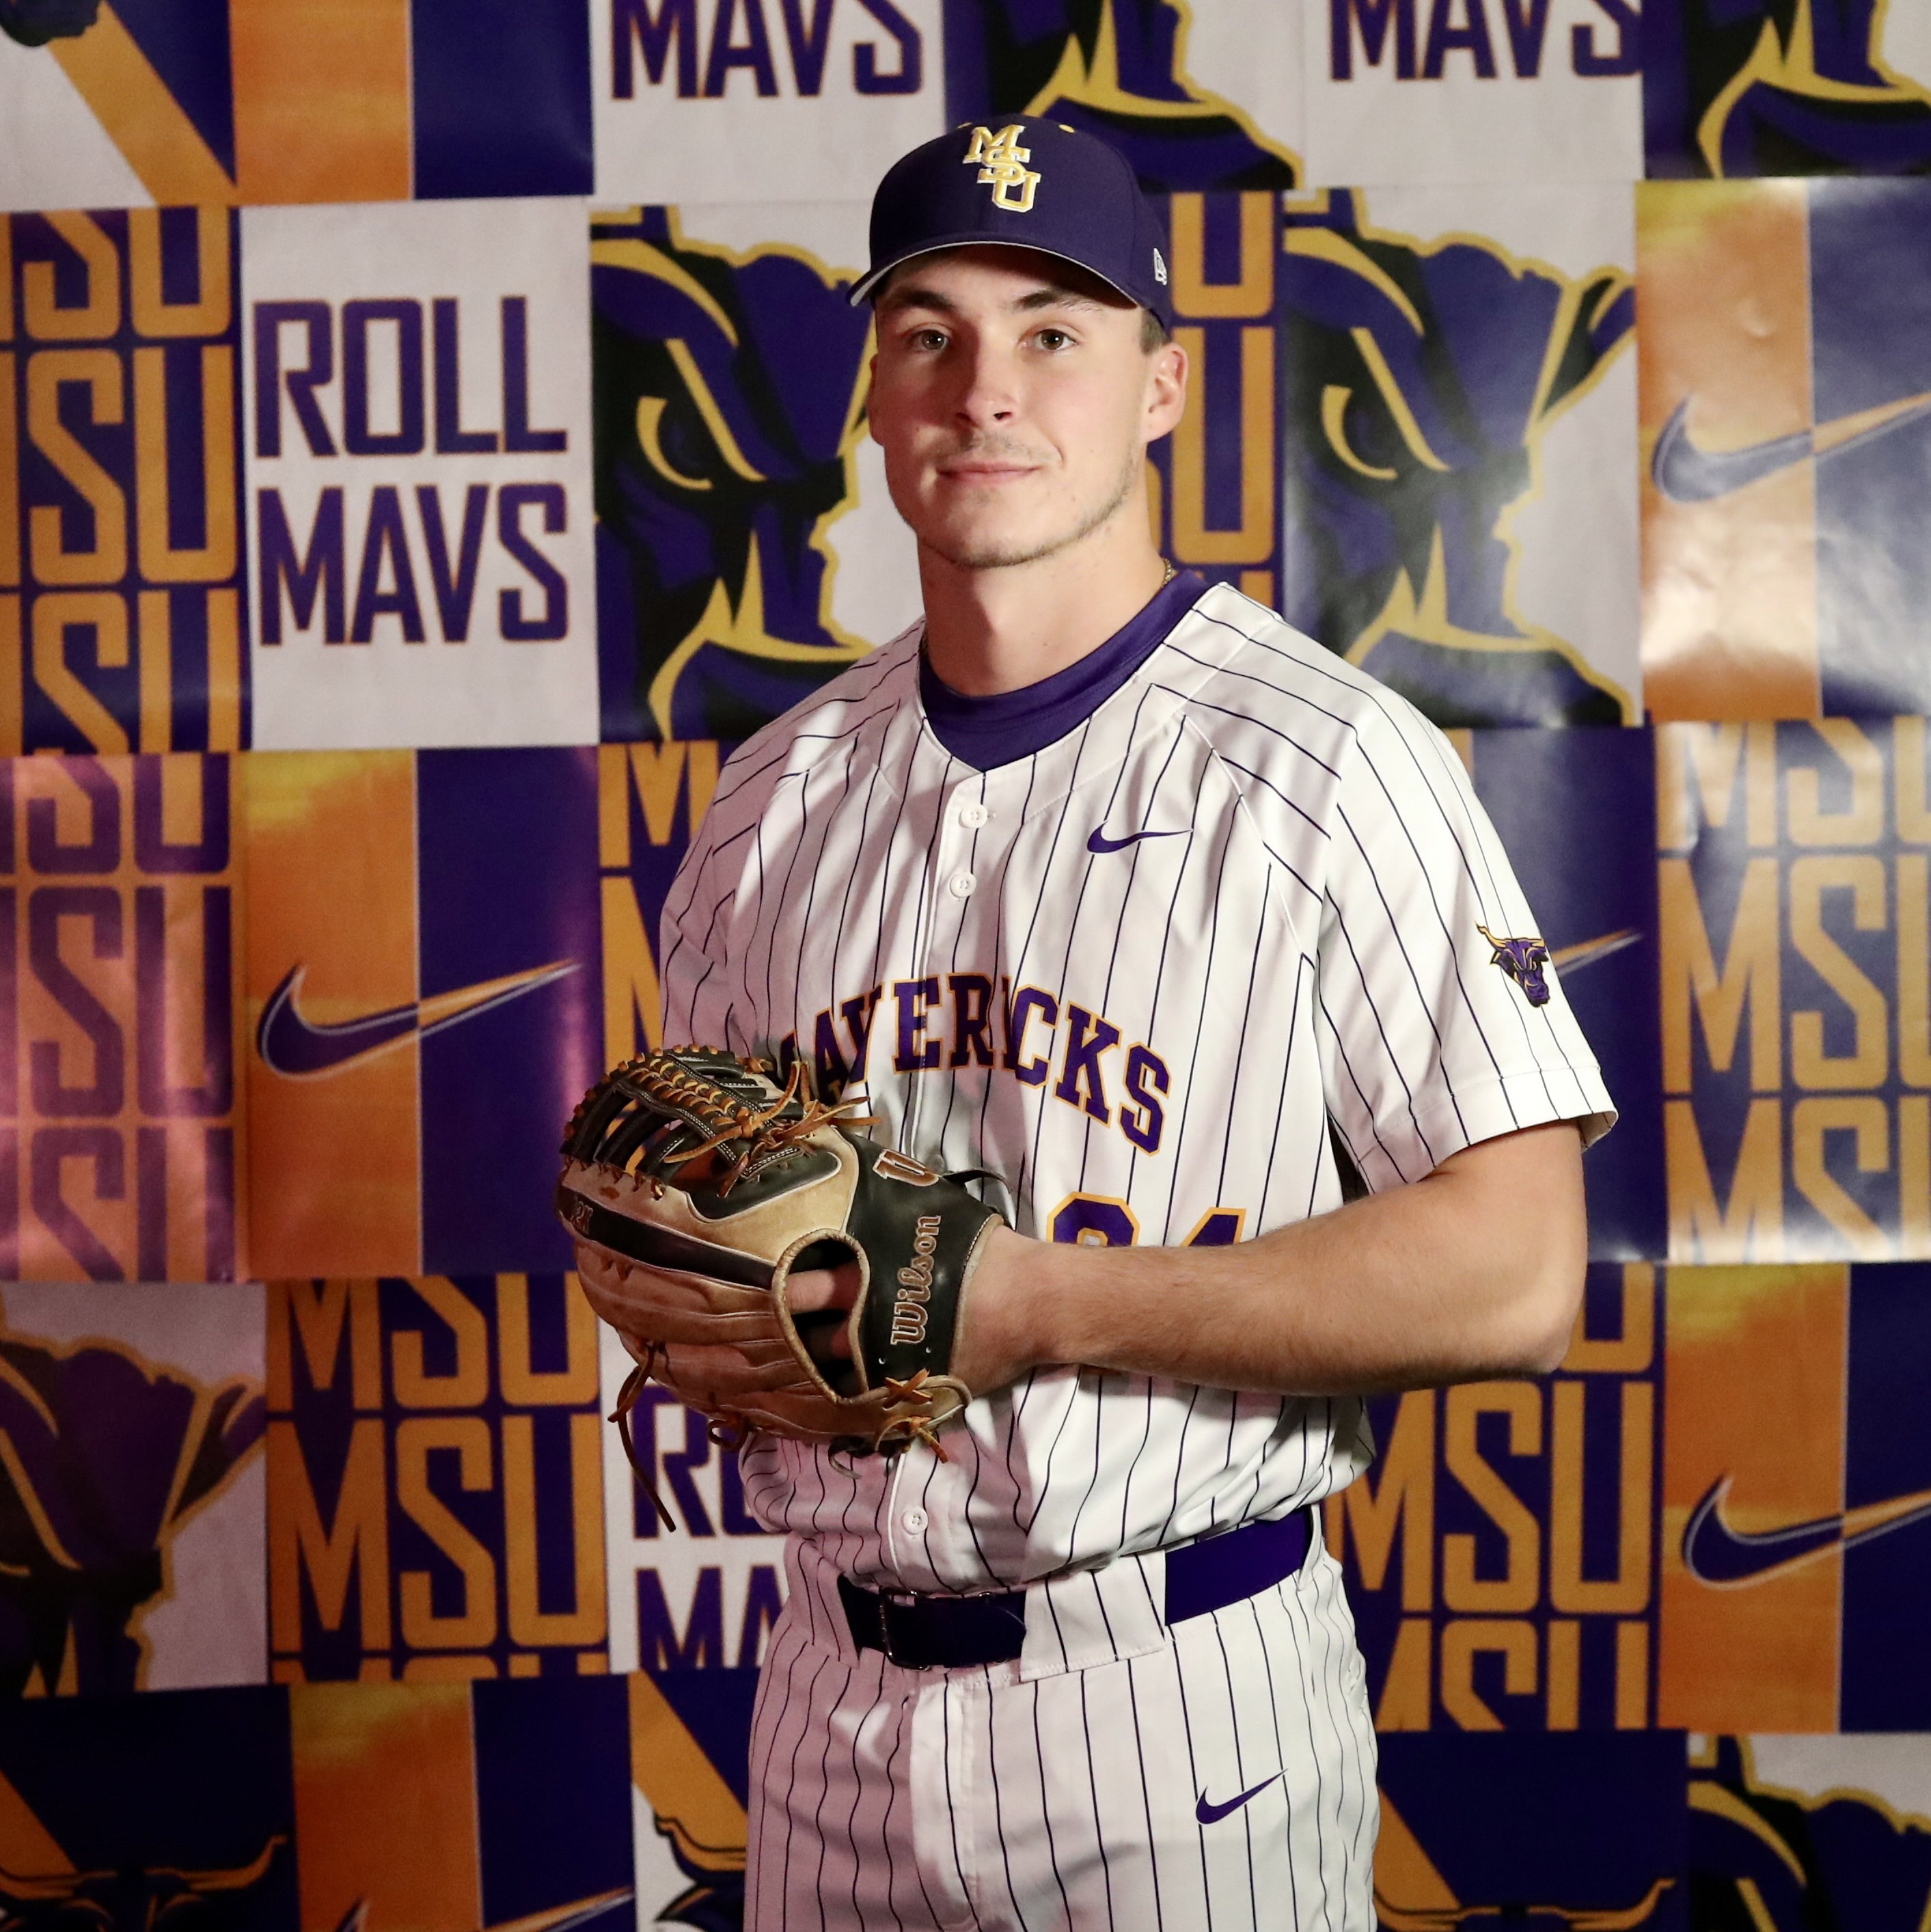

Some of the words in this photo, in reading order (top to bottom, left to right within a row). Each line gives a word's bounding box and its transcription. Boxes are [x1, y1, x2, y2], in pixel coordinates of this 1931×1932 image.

[612, 0, 922, 100] MAVS
[962, 124, 1042, 213] MSU
[0, 208, 231, 340] SU
[253, 295, 567, 459] ROLL
[0, 345, 238, 588] SU
[257, 482, 569, 647] MAVS
[0, 885, 234, 1118] SU
[779, 972, 1171, 1156] AVERICKS
[890, 1214, 941, 1346] Wilson
[275, 1412, 608, 1653] MSU
